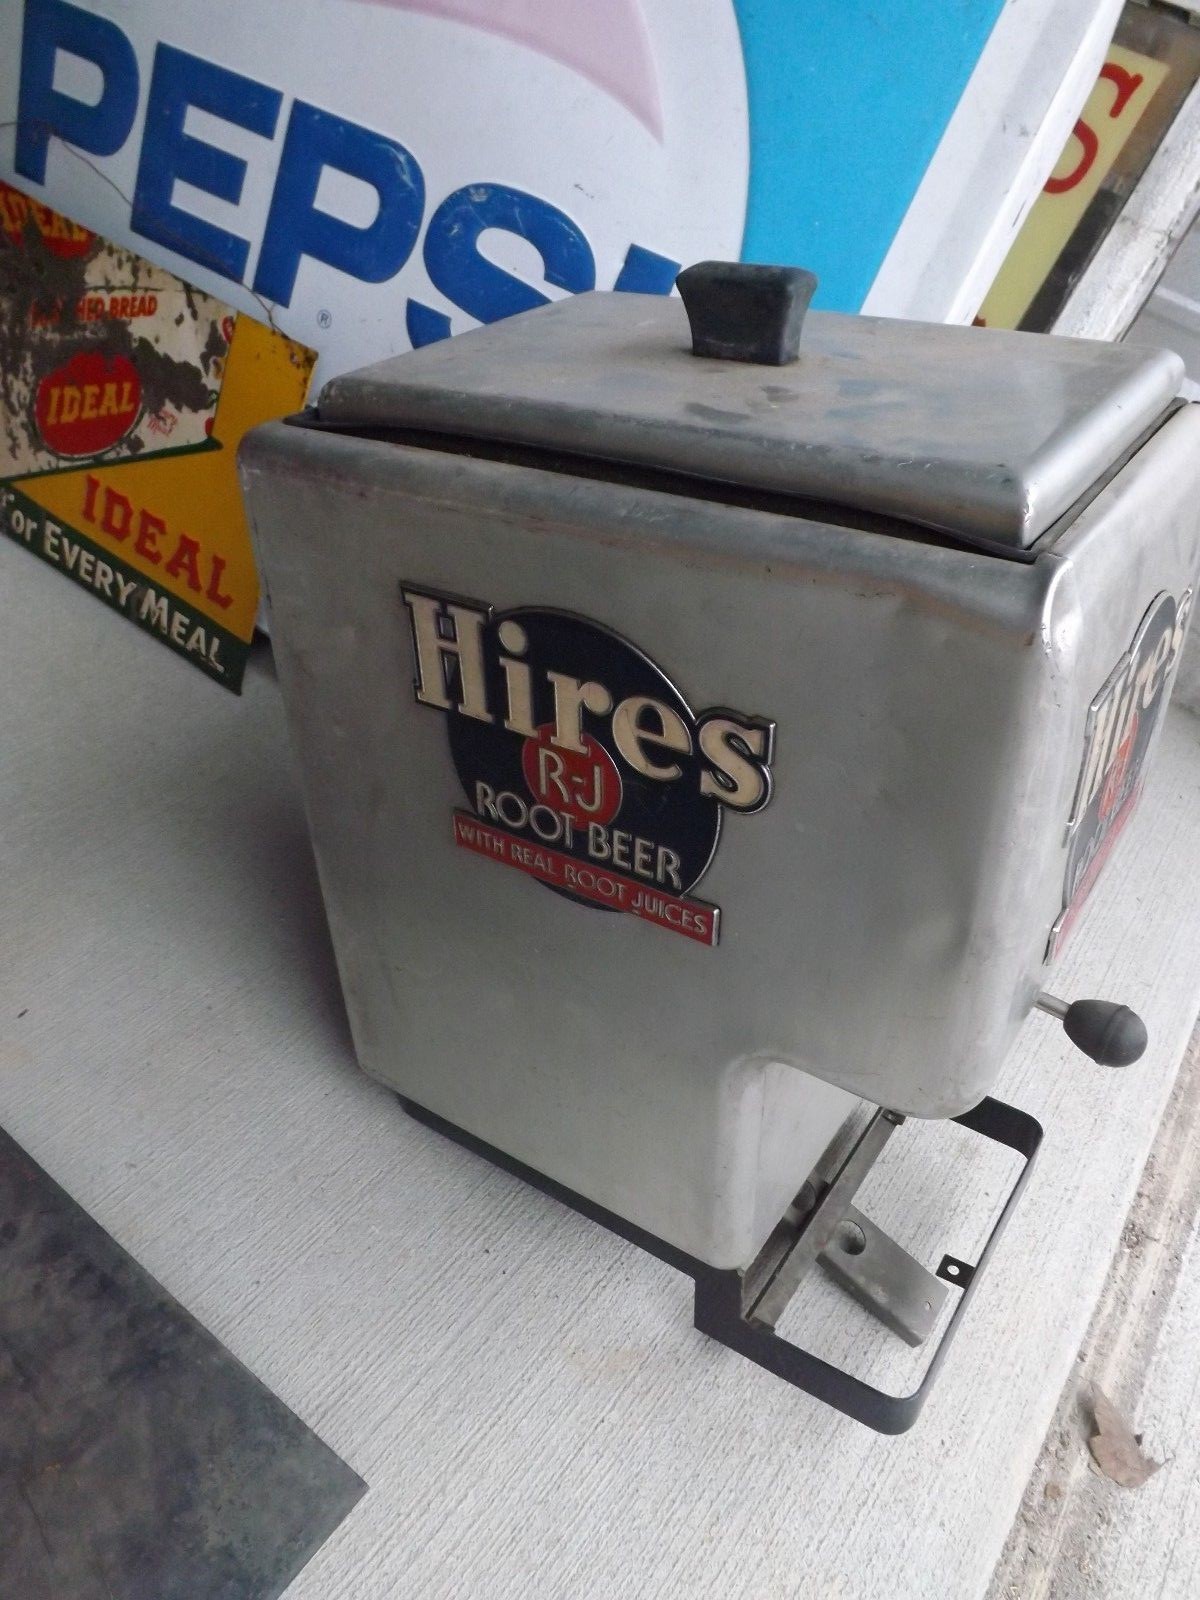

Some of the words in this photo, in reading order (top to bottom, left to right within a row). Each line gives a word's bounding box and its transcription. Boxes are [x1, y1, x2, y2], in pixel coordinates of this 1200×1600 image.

[14, 0, 683, 350] PEPS
[109, 296, 157, 318] BREAD
[47, 382, 134, 424] IDEAL
[44, 520, 136, 606] EVERY
[141, 589, 225, 673] MEAL
[81, 474, 233, 610] IDEAL
[404, 590, 769, 810] Hires
[475, 780, 575, 850] ROOT
[588, 820, 682, 890] BEER
[537, 748, 604, 812] R-J
[458, 822, 505, 858] WITH
[510, 844, 558, 877] REAL
[564, 864, 626, 903] ROOT
[630, 889, 707, 935] JUICES
